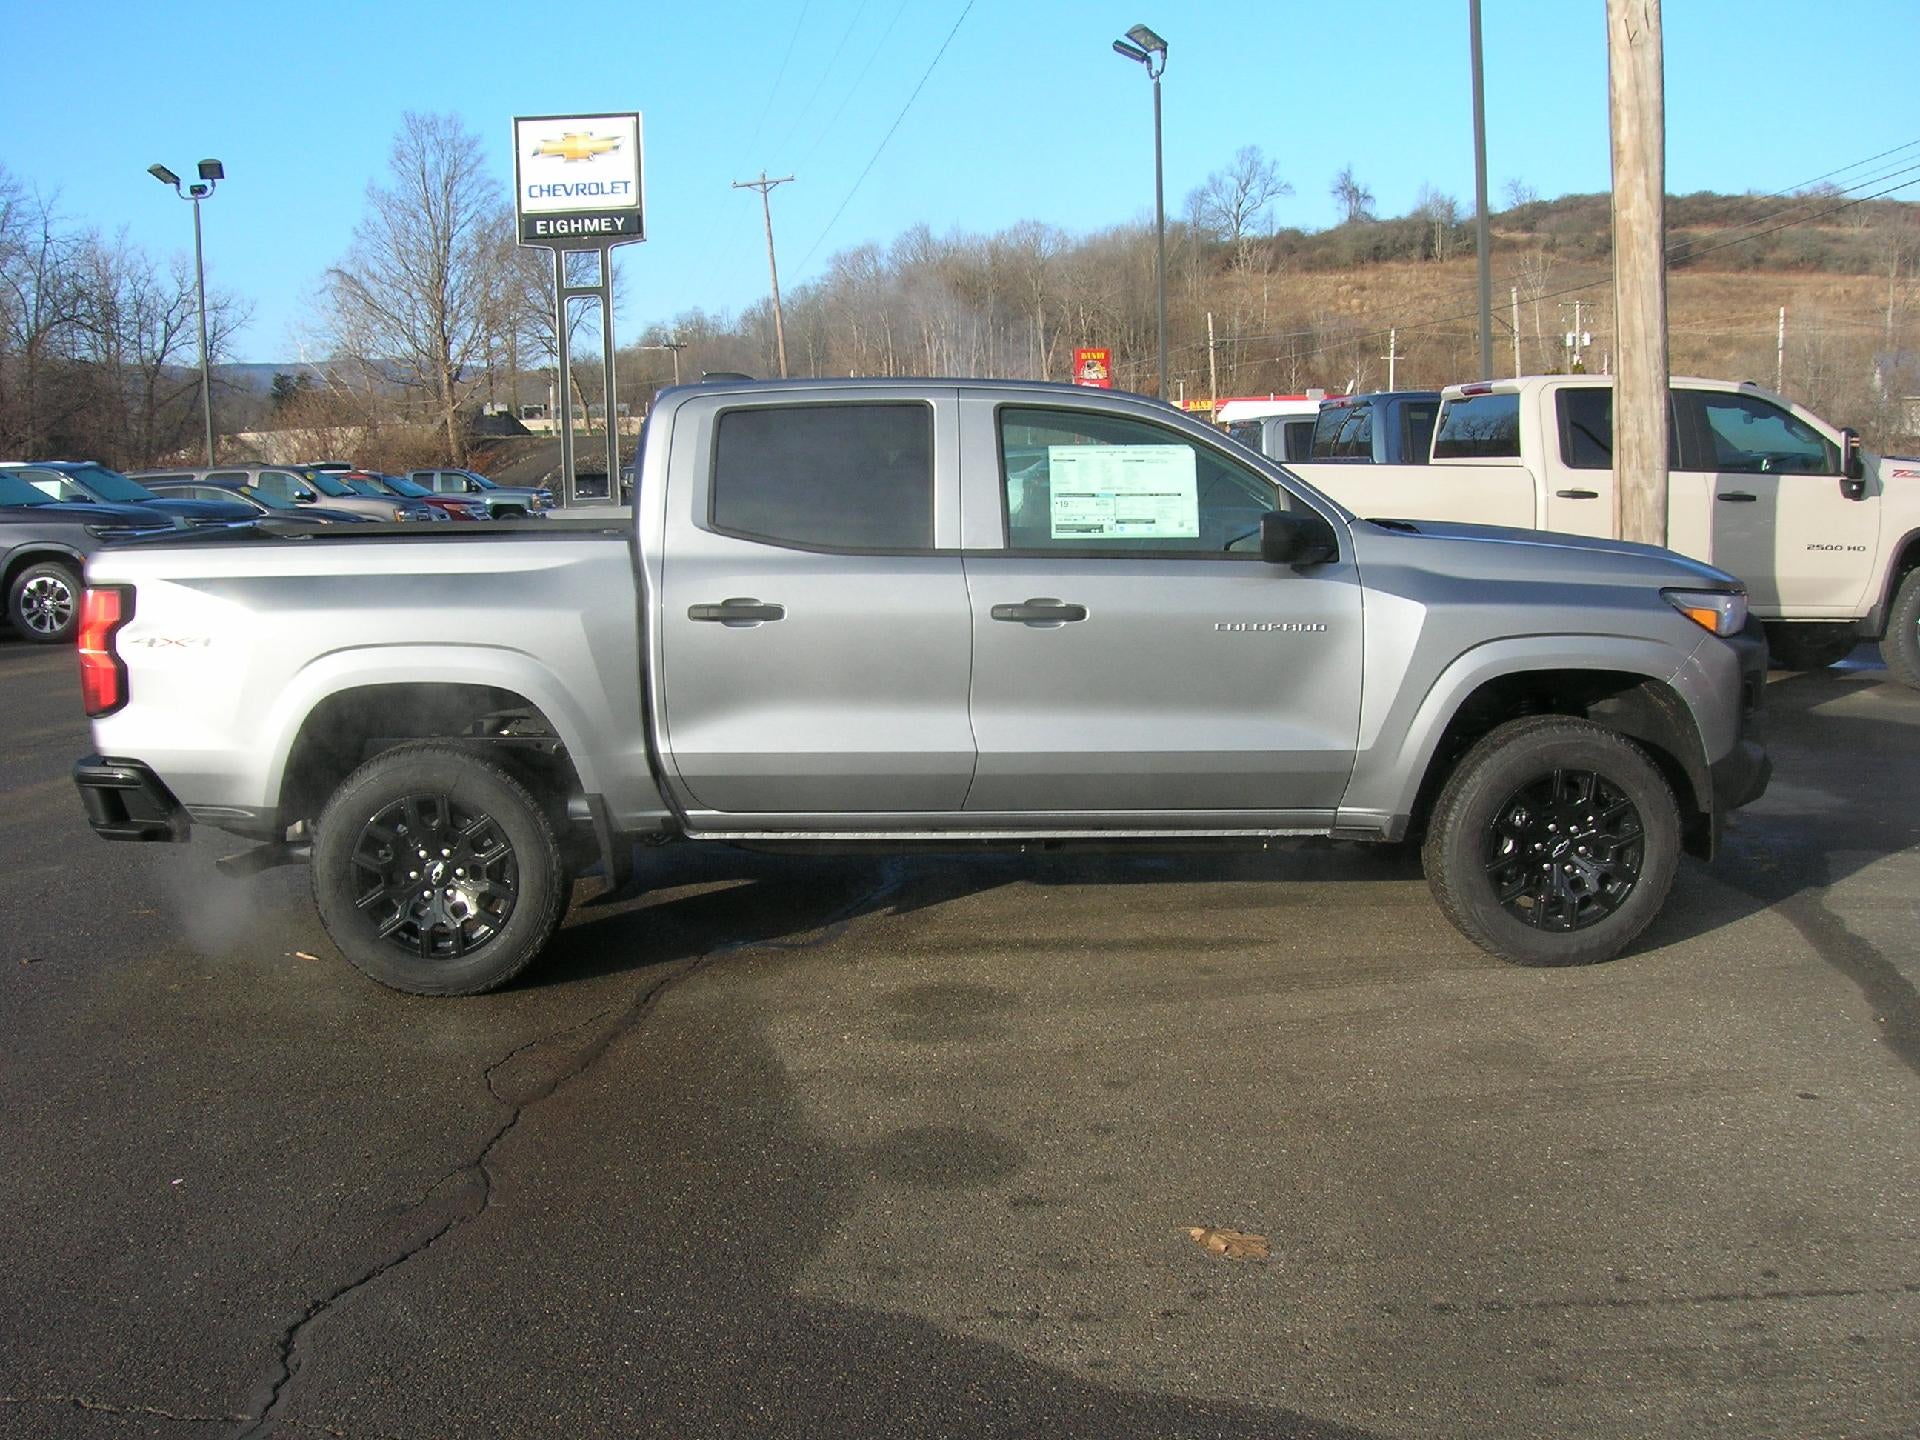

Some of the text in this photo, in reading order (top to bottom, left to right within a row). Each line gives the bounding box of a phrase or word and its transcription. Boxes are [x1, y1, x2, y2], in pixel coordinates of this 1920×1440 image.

[528, 181, 631, 198] CHEVROLET
[536, 217, 625, 234] EIGHMEY
[1806, 543, 1867, 552] 2500 HD
[1214, 623, 1327, 632] COLORADO
